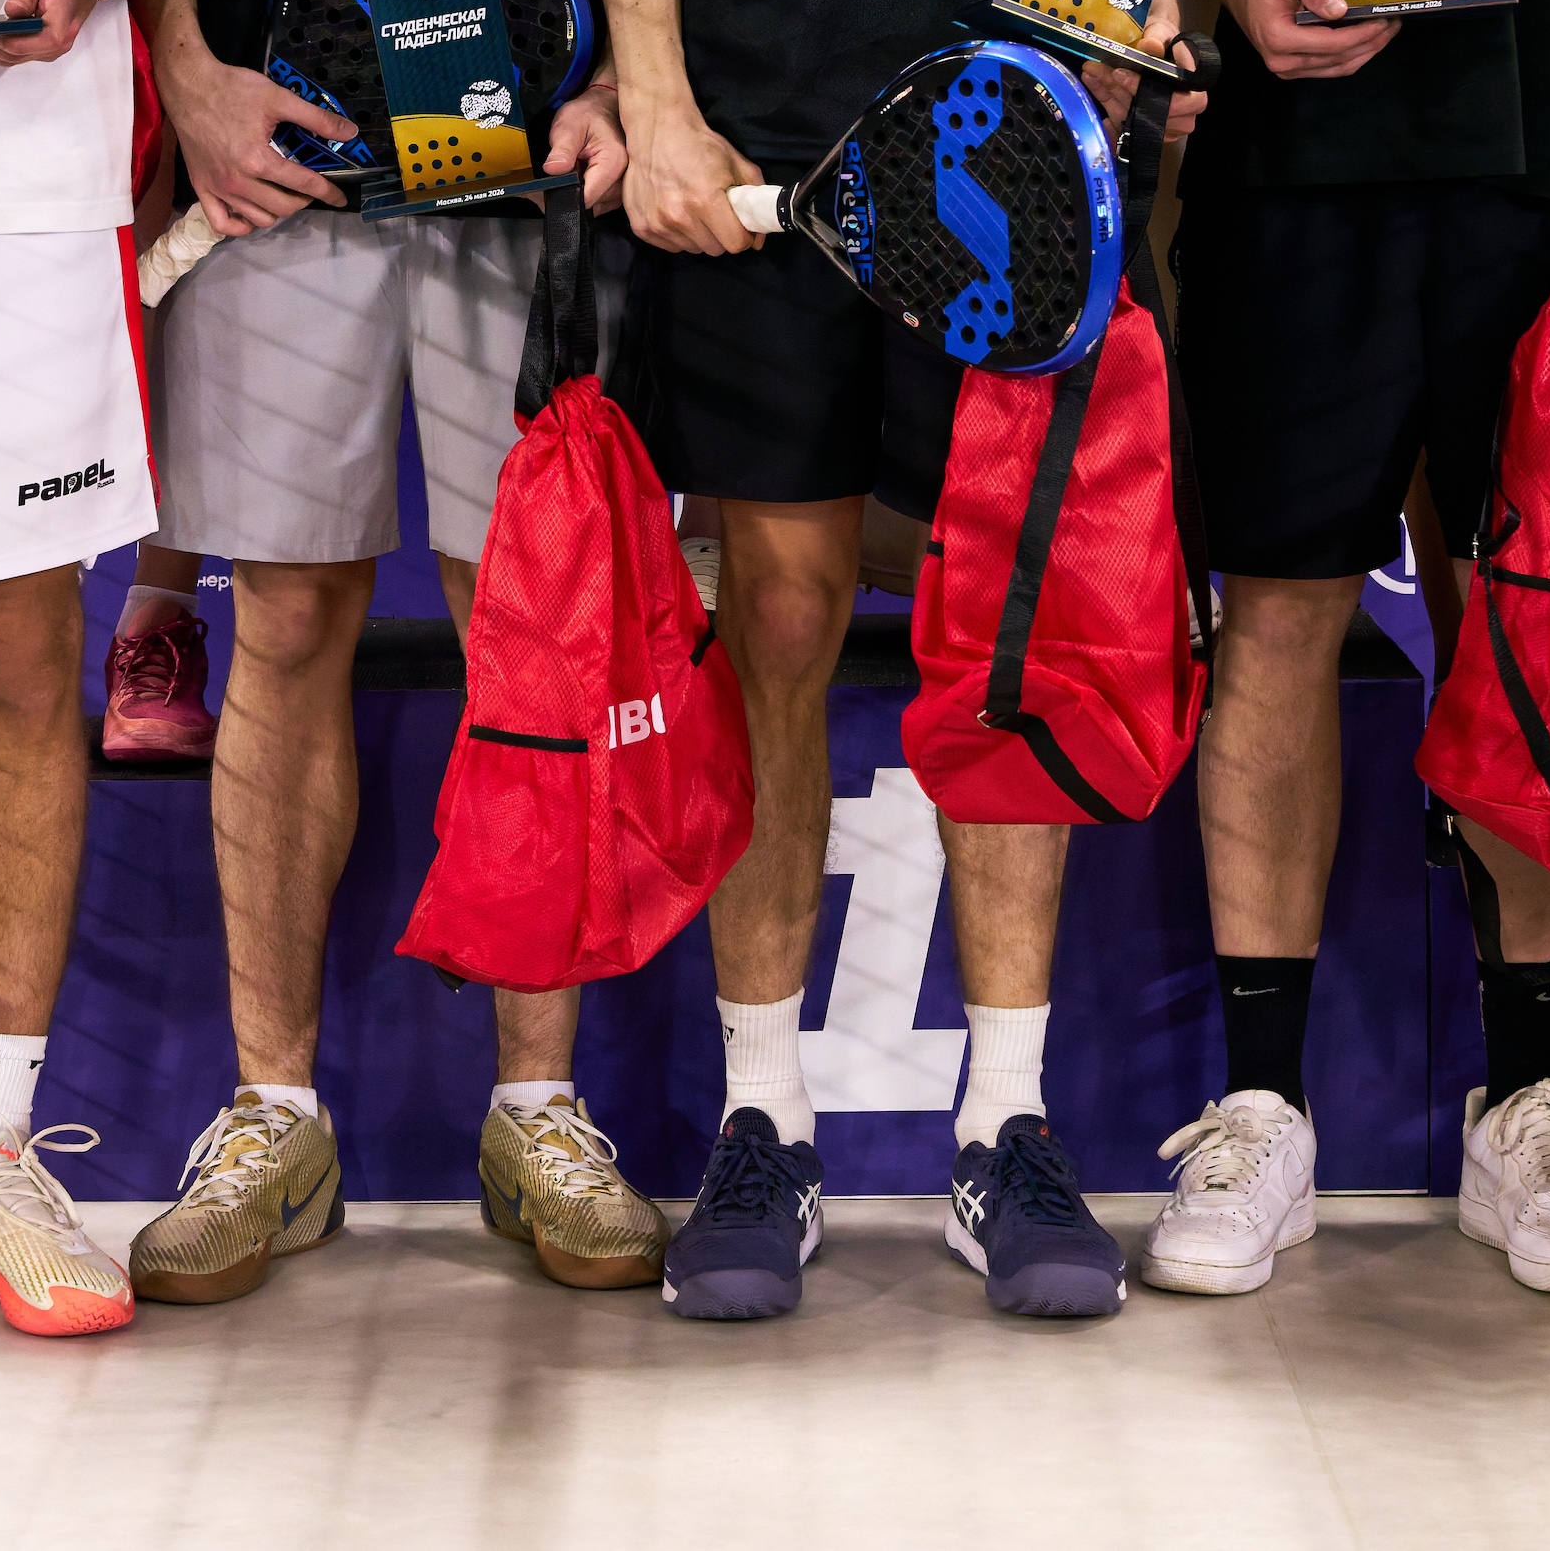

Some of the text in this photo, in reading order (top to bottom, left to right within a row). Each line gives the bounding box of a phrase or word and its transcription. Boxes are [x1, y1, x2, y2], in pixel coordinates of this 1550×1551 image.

[380, 7, 487, 38] СТУДЕНЧЕСКАЯ
[394, 23, 483, 51] ПАДЕЛ-ЛИГА
[1033, 83, 1063, 122] SLICE
[1092, 177, 1109, 243] PRISMA
